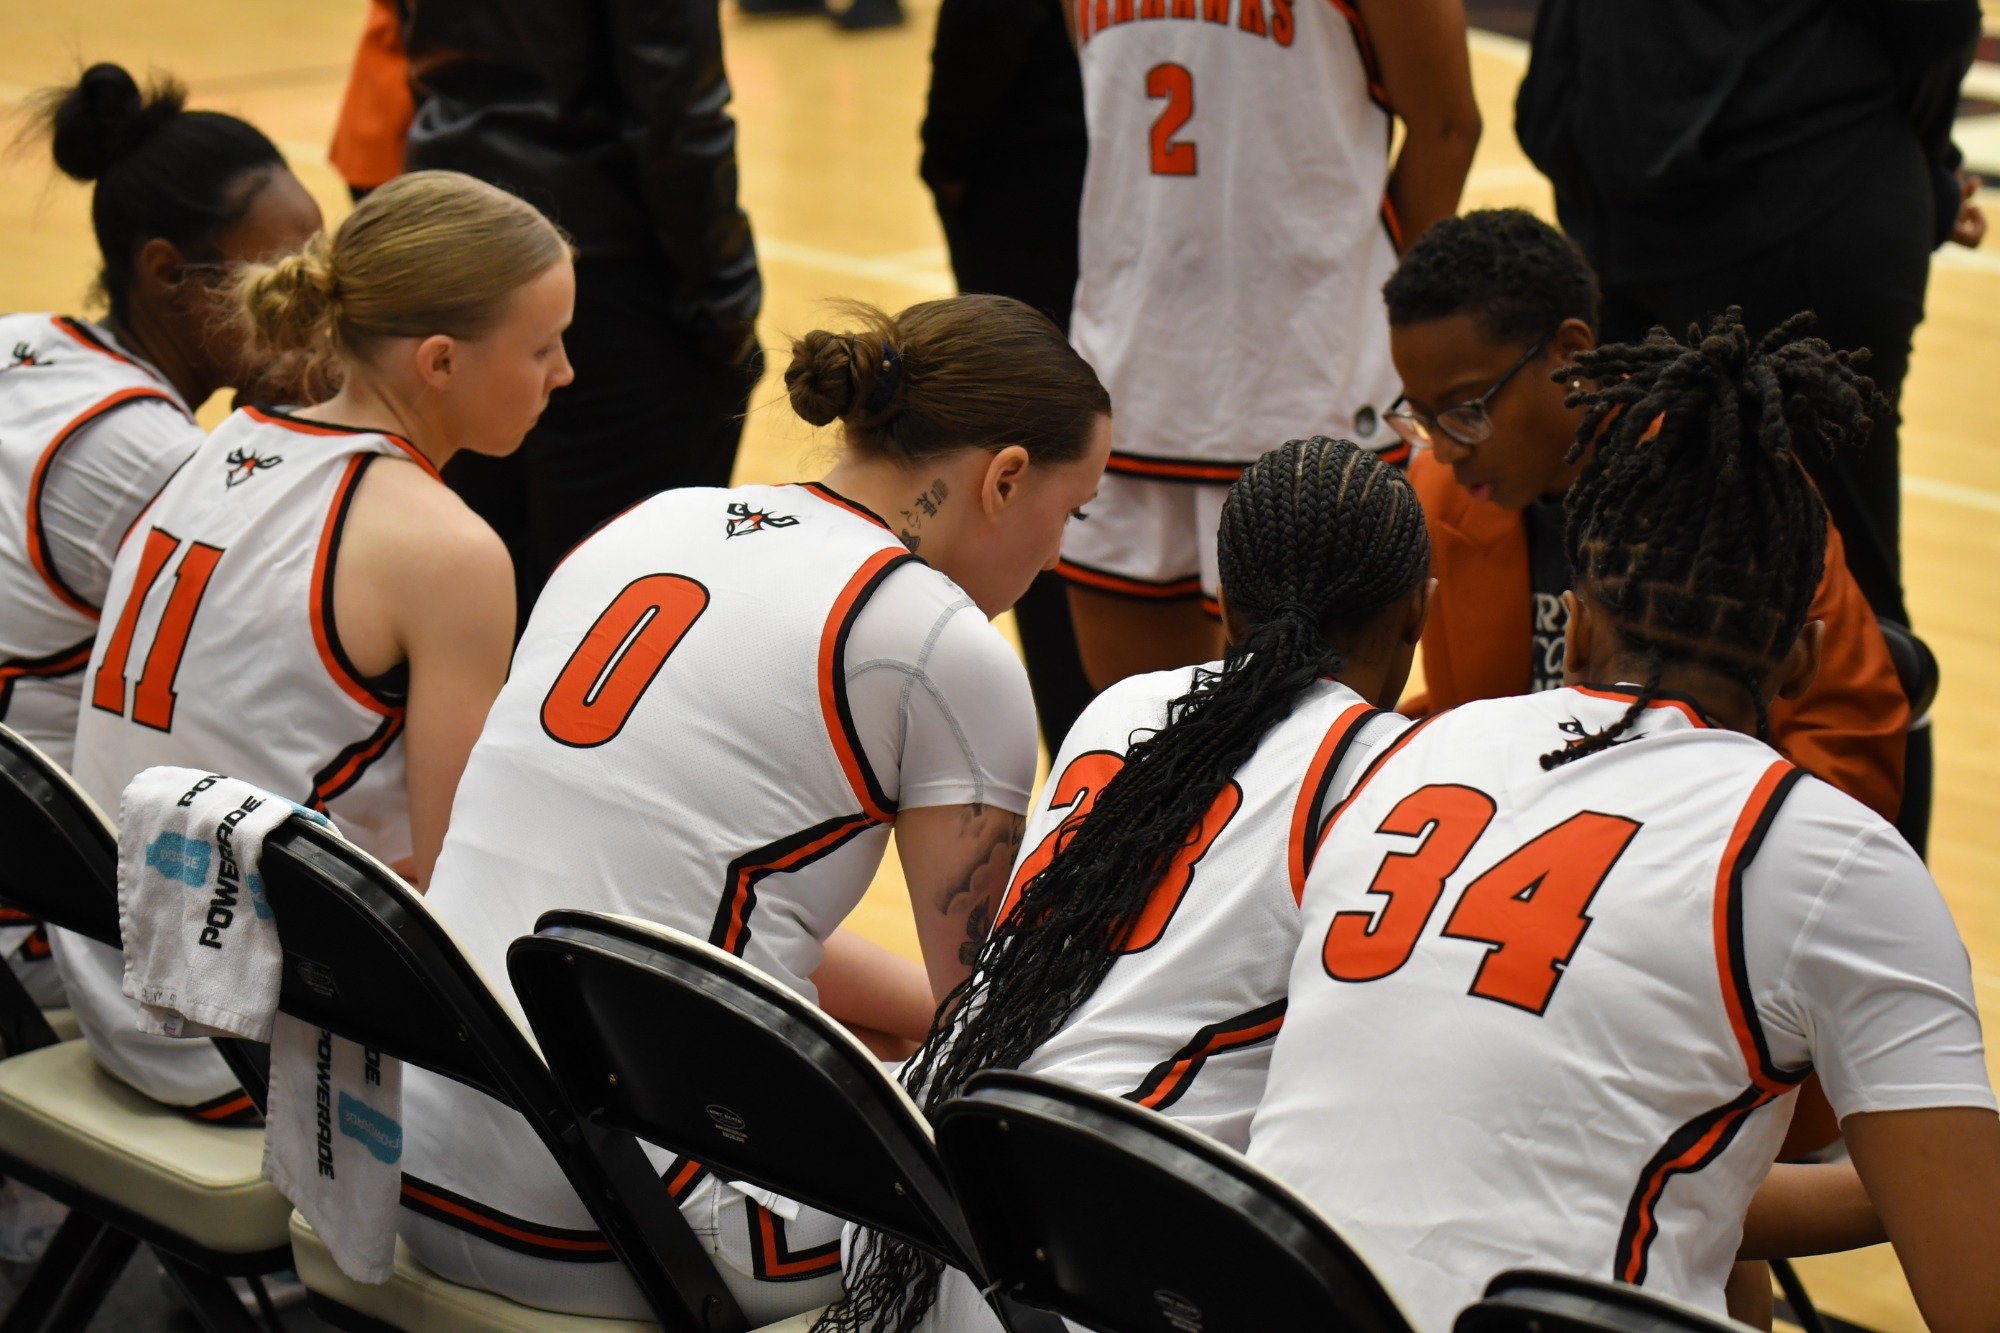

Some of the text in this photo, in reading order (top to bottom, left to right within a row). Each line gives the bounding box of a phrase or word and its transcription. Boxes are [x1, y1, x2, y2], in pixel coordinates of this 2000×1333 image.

[1145, 62, 1197, 176] 2
[92, 525, 227, 733] 11
[540, 573, 711, 749] 0
[199, 795, 259, 949] POWERADE
[1322, 783, 1645, 1017] 34
[317, 1029, 335, 1180] POWERADE
